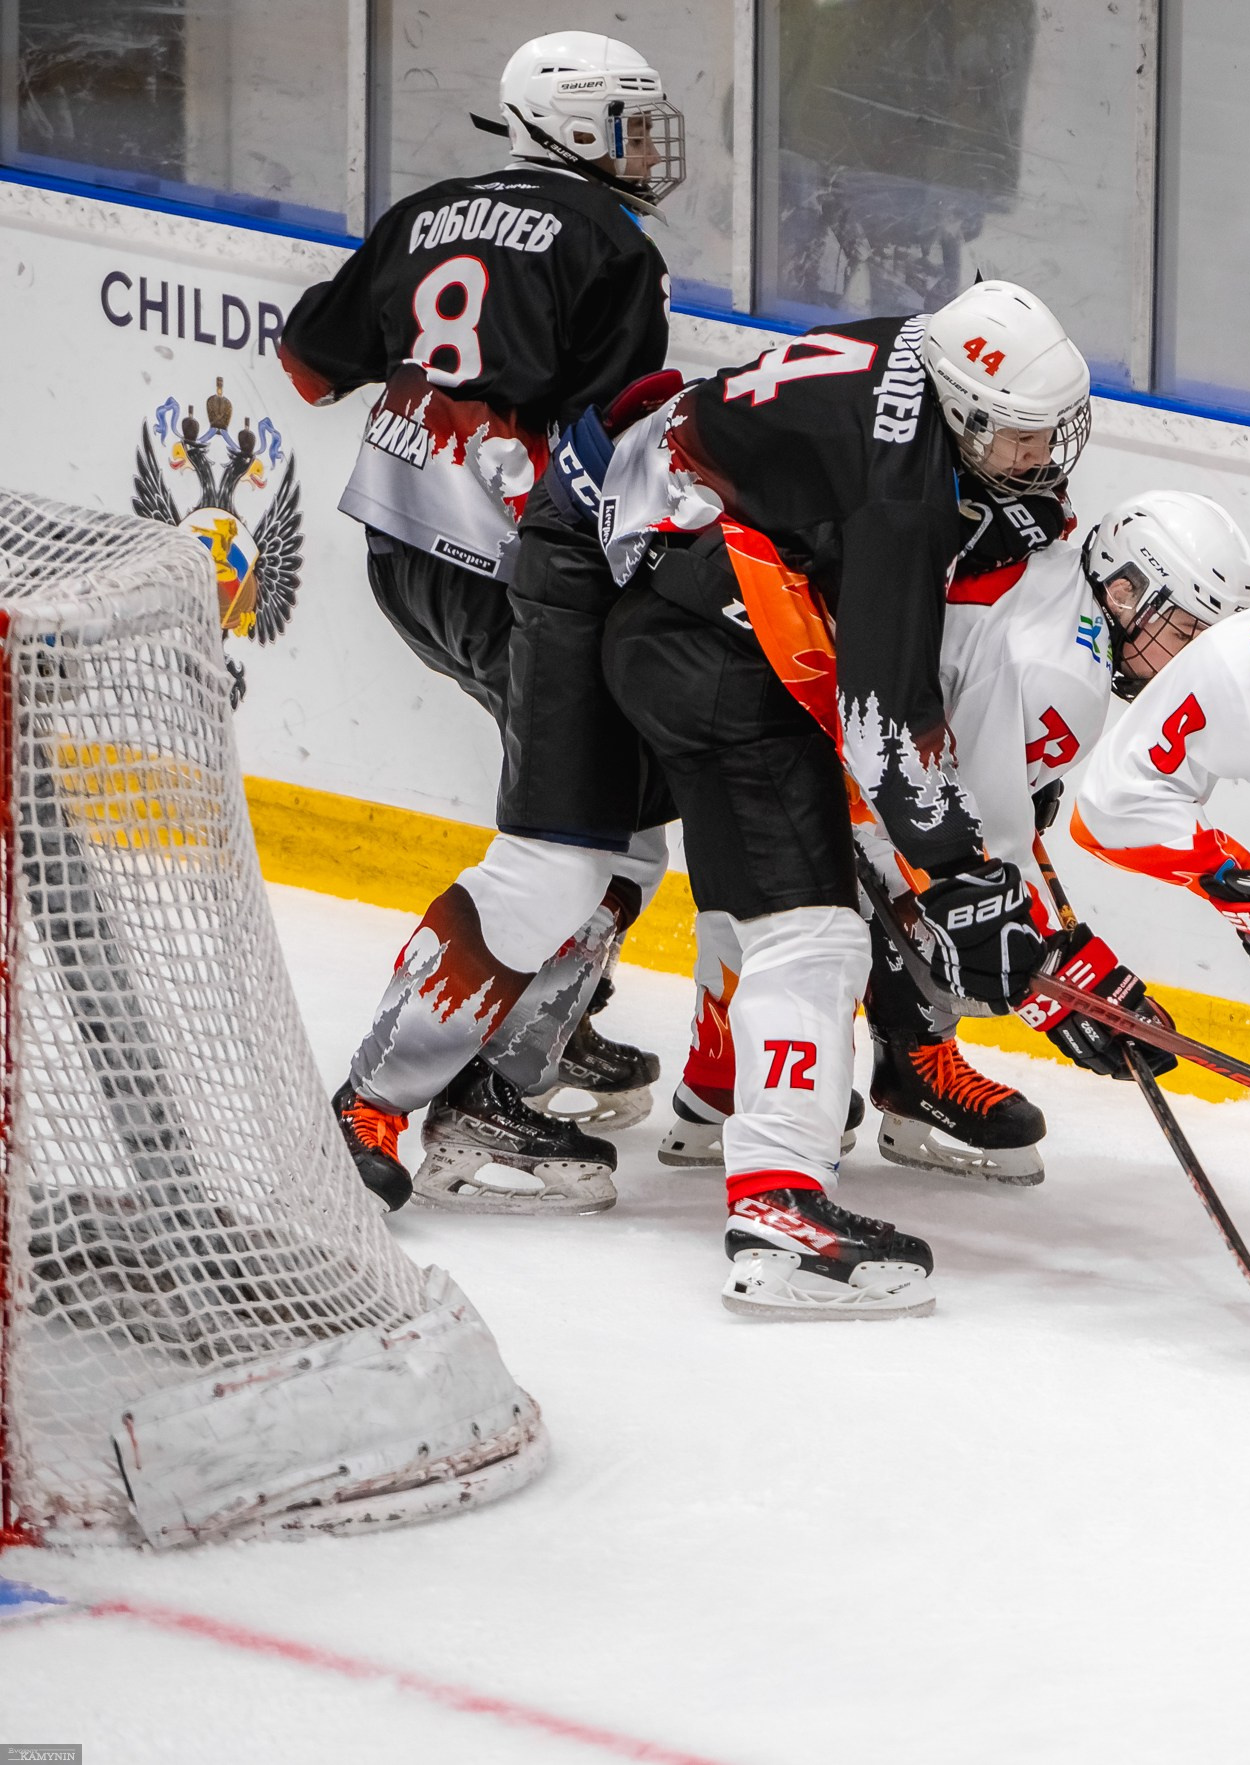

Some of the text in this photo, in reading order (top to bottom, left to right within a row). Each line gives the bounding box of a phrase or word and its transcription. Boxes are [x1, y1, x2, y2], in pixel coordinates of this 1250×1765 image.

[409, 198, 562, 254] СОБОЛЕВ
[100, 270, 284, 359] CHILDR
[411, 254, 490, 388] 8
[936, 368, 969, 395] BAUER
[962, 336, 1007, 377] 44
[558, 441, 602, 518] CC
[441, 541, 493, 570] keeper
[1139, 546, 1170, 578] CCM
[947, 880, 1026, 931] BAU
[763, 1039, 816, 1090] 72
[920, 1099, 957, 1129] CCM
[733, 1197, 836, 1250] CCM
